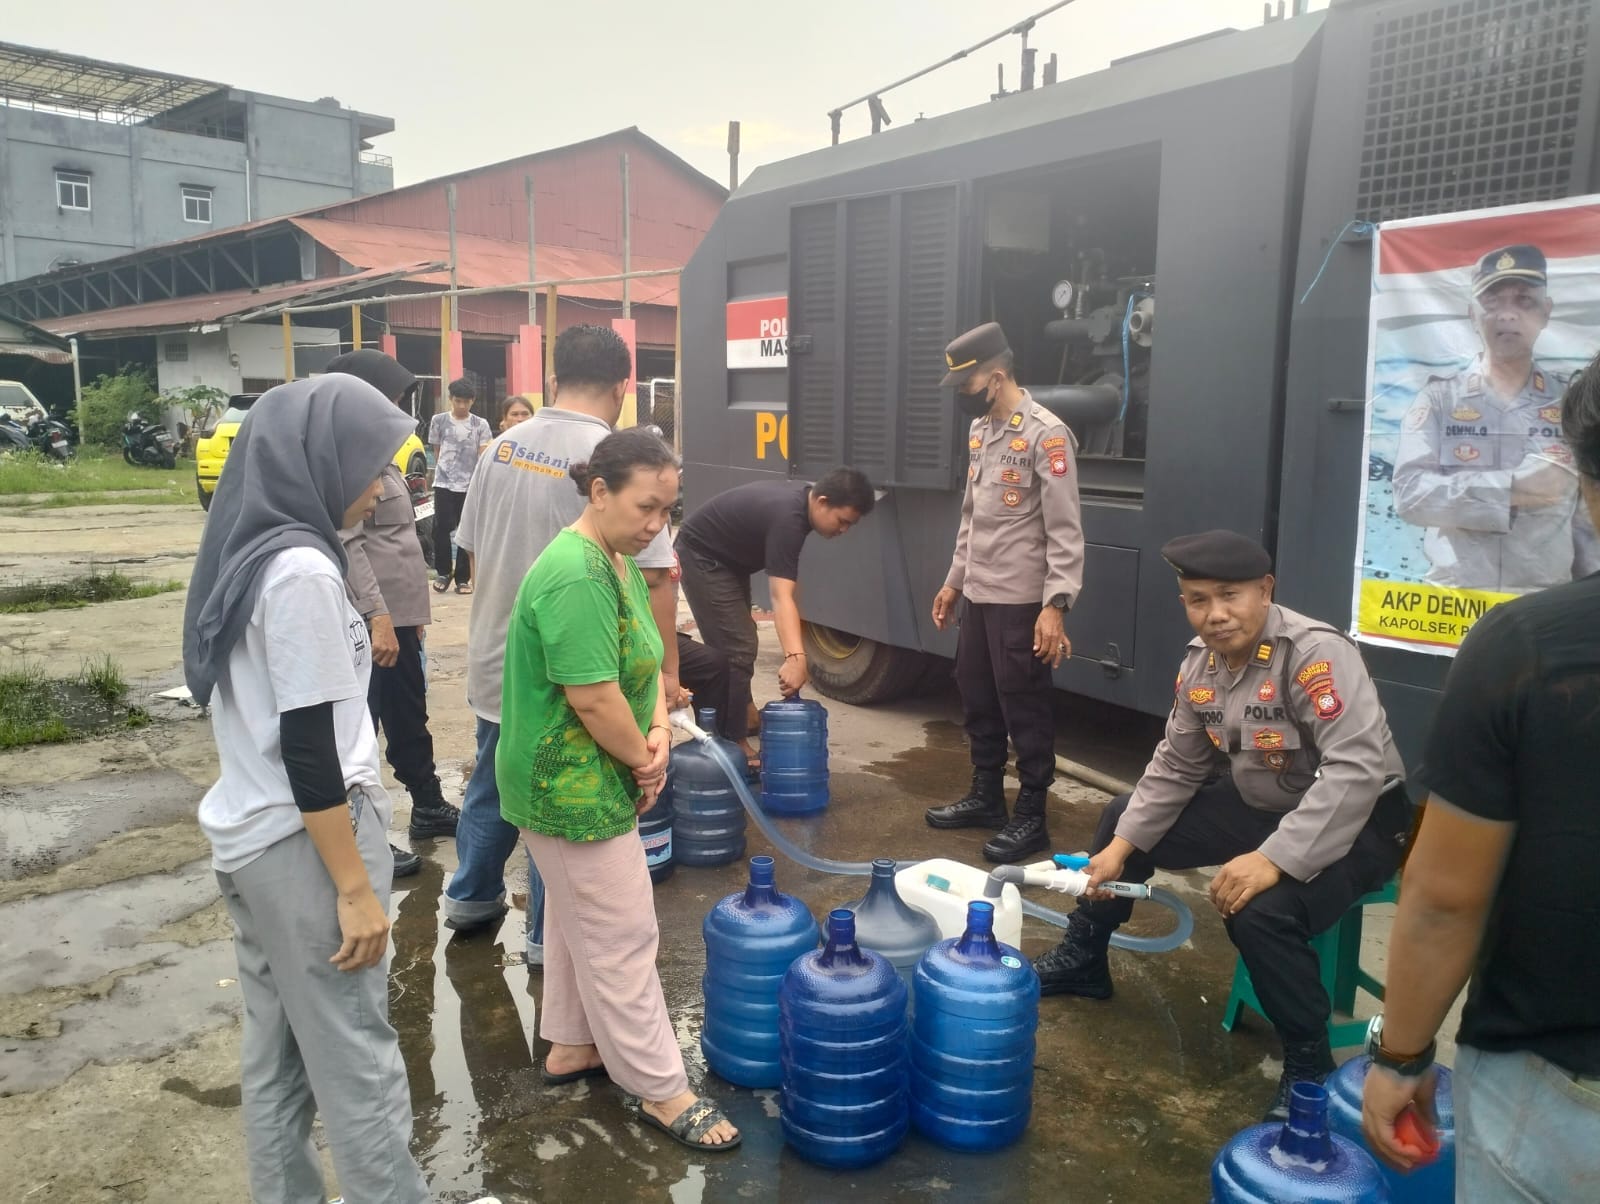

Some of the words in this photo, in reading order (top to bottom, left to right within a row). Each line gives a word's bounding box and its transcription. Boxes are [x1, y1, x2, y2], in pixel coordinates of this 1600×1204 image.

[1000, 454, 1032, 468] POLRI
[1381, 590, 1422, 612] AKP
[1379, 615, 1457, 636] KAPOLSEK
